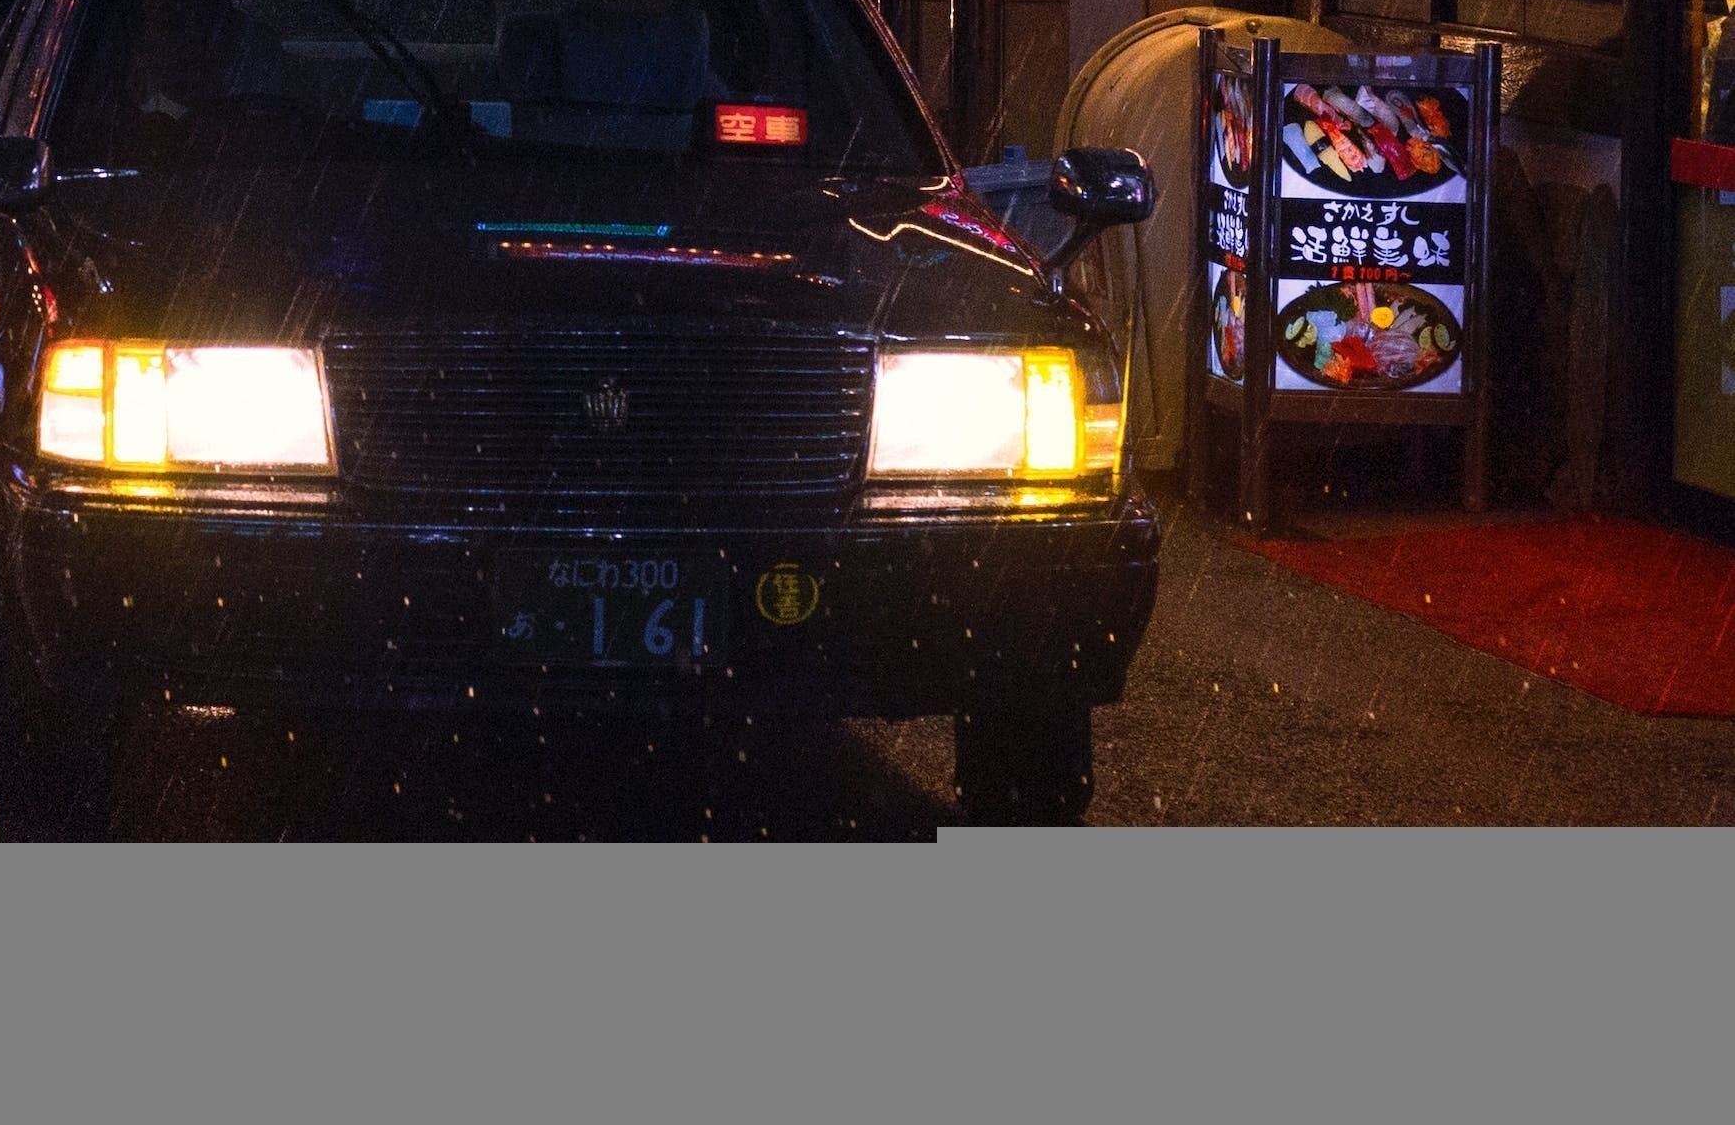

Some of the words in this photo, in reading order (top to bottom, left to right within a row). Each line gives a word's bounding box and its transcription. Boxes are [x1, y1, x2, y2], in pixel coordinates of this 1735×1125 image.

[718, 112, 801, 143] 空車
[1323, 201, 1420, 226] さかえすし
